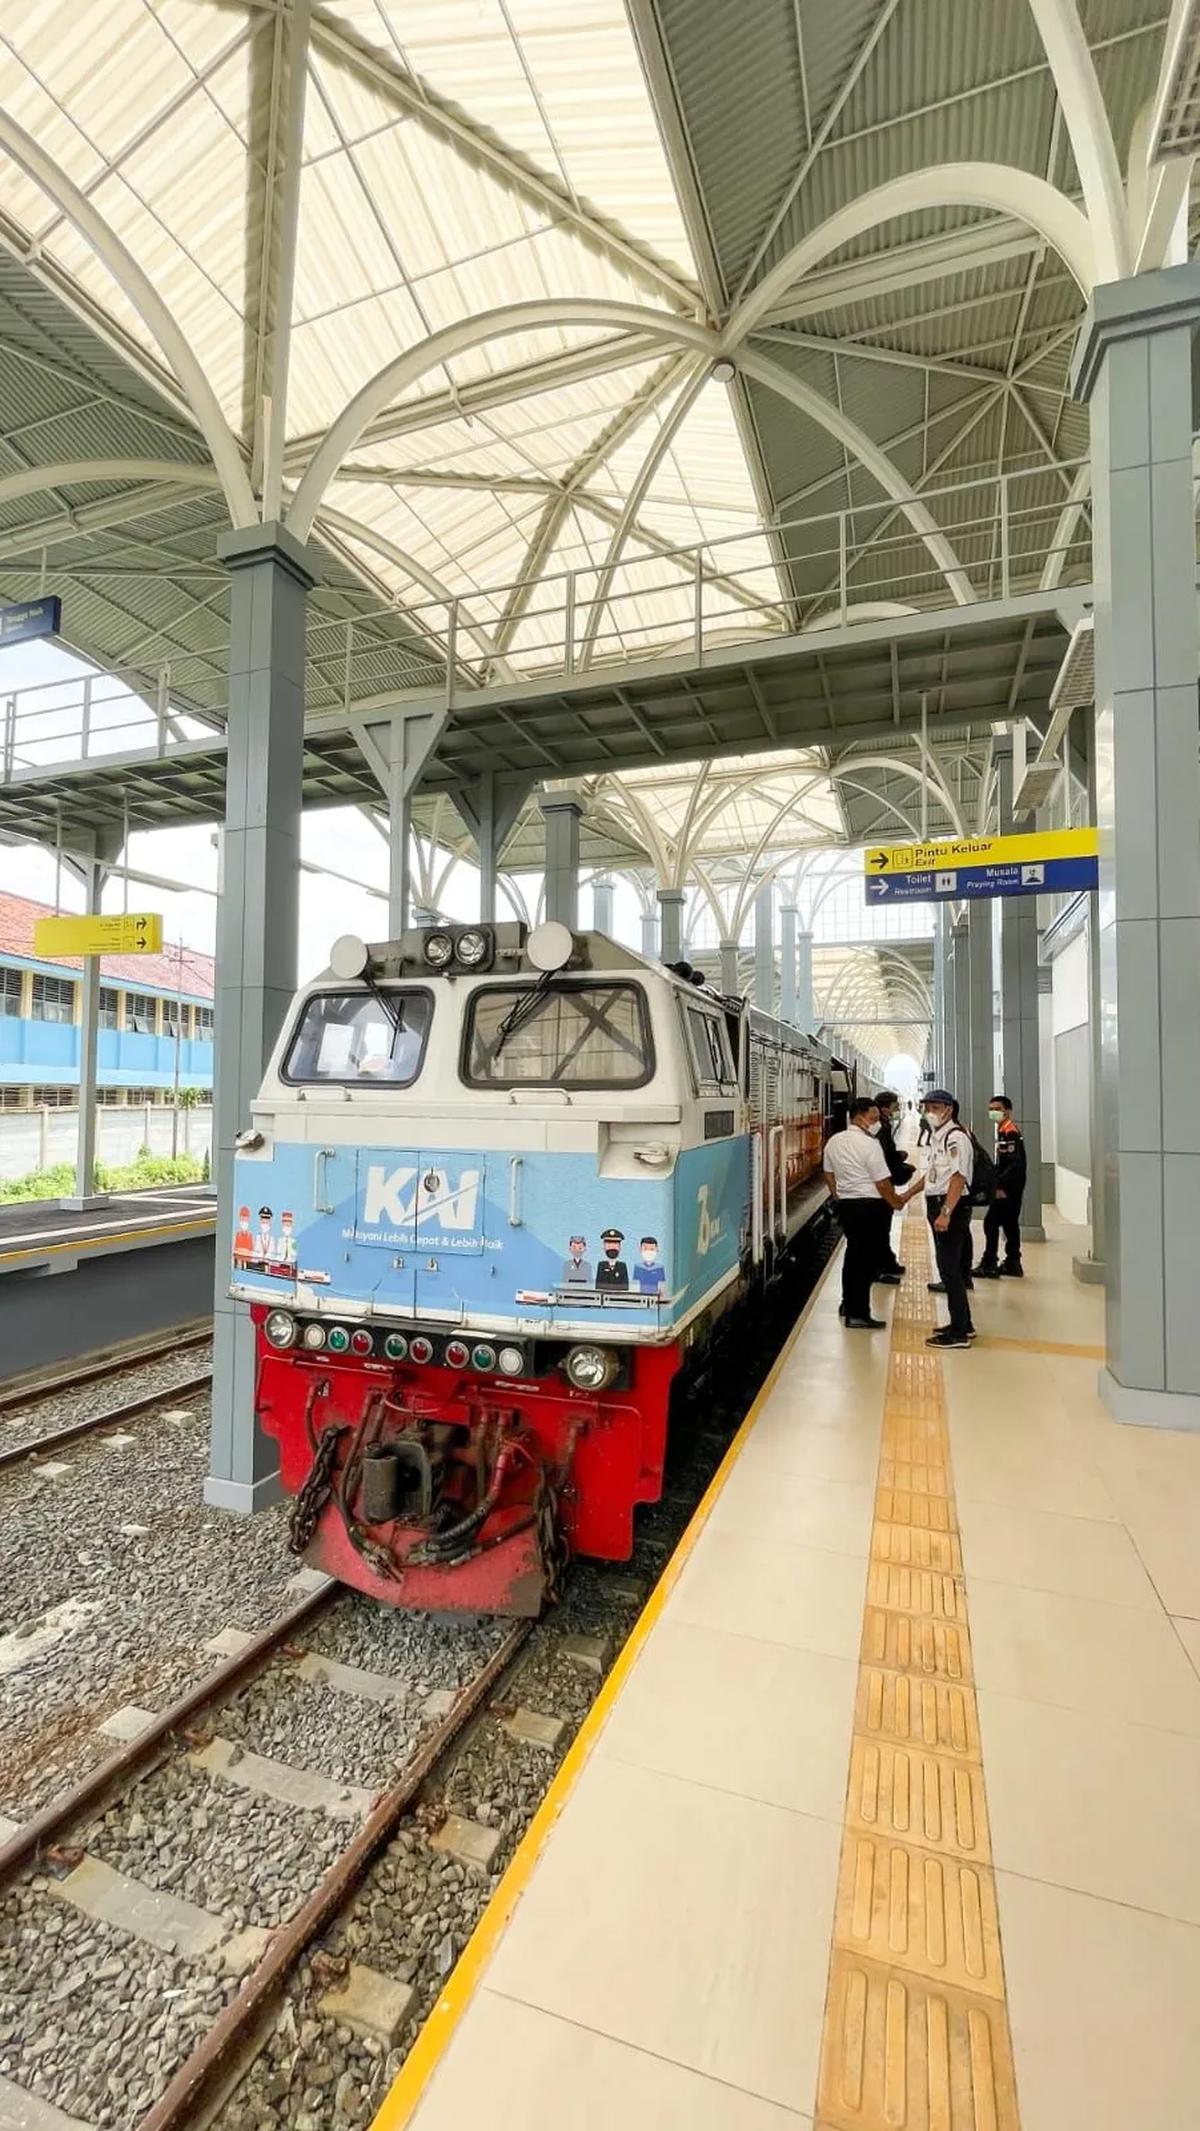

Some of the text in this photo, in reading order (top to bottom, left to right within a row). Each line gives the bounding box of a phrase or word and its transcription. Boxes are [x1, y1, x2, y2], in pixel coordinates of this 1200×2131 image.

[915, 842, 993, 858] Pintu Keluar
[915, 859, 935, 867] Exit
[906, 874, 931, 885] Toilet
[364, 1166, 480, 1230] KAI
[441, 1236, 450, 1246] &
